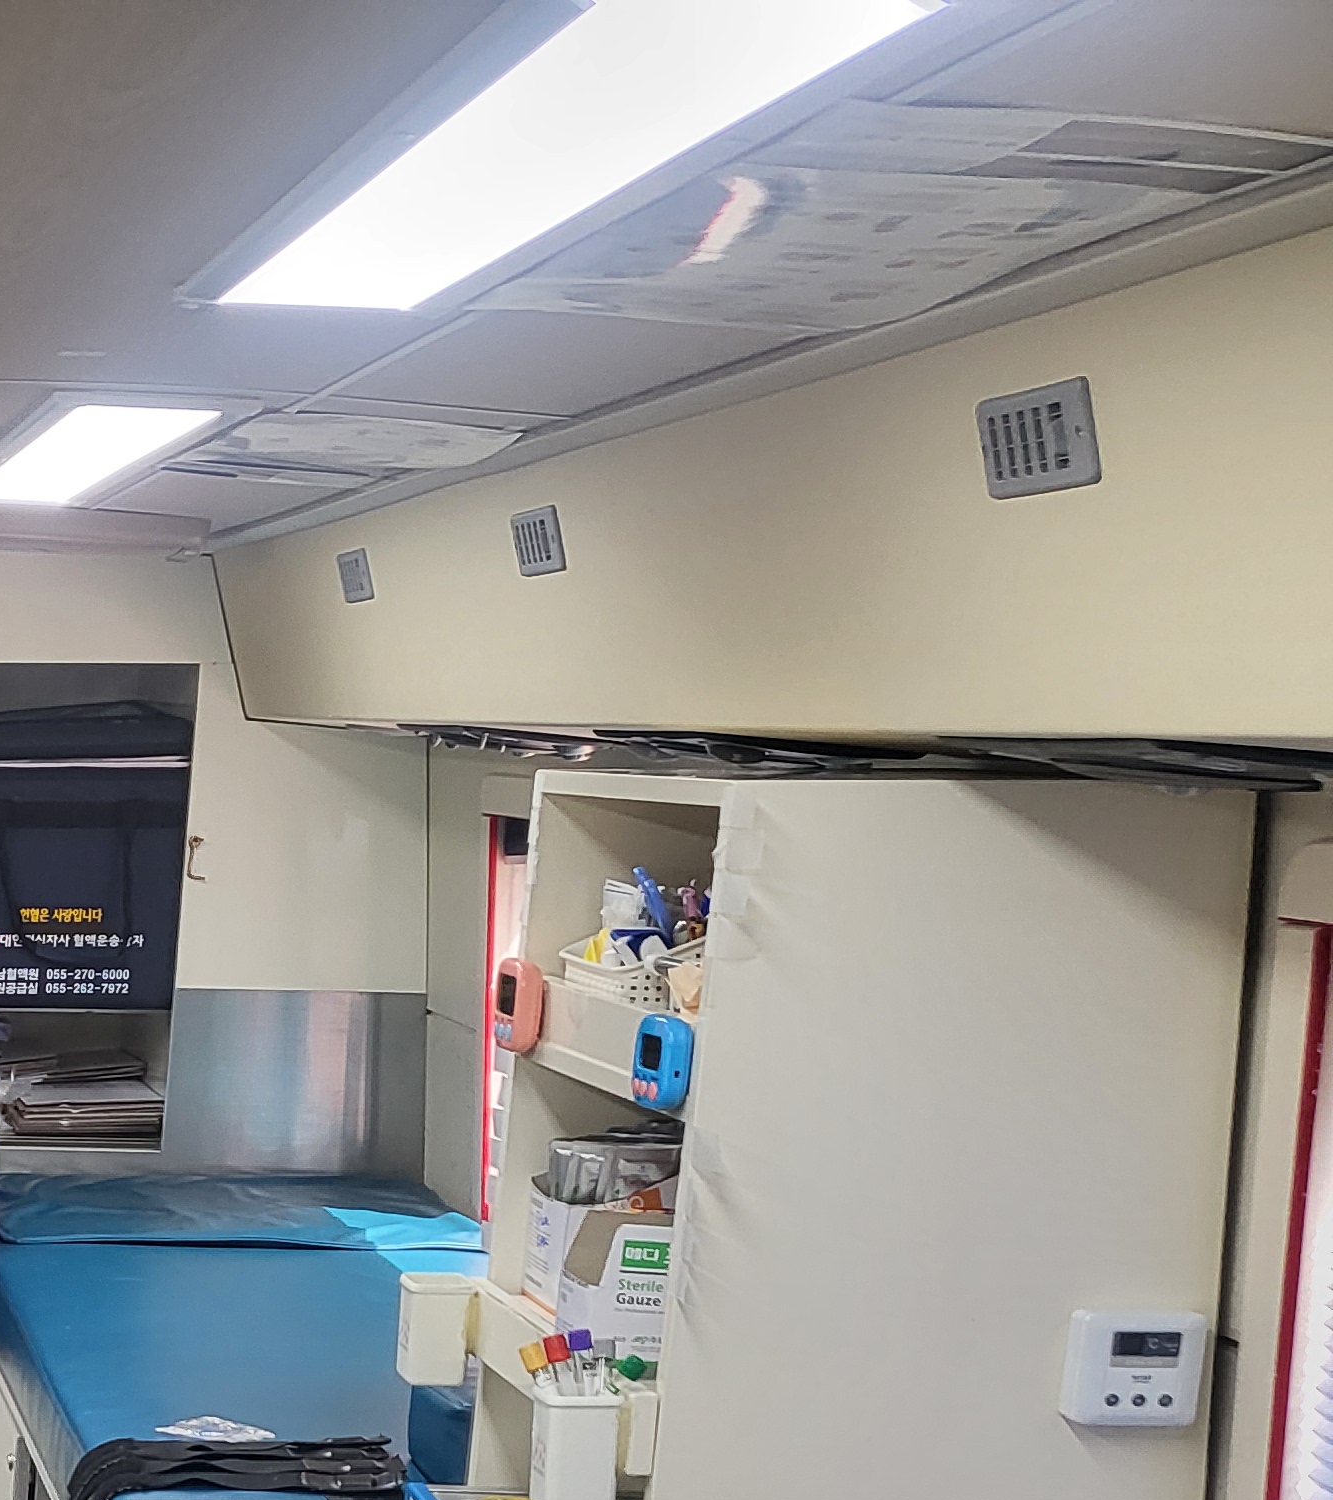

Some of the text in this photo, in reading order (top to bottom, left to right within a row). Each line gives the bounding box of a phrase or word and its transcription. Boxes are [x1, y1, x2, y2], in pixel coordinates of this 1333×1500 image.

[19, 908, 103, 923] 헌혈은 사랑입니다
[46, 968, 130, 981] 055-270-6000
[45, 983, 129, 995] 055-262-7972
[618, 1278, 664, 1293] Sterile
[616, 1292, 662, 1307] Gauze
